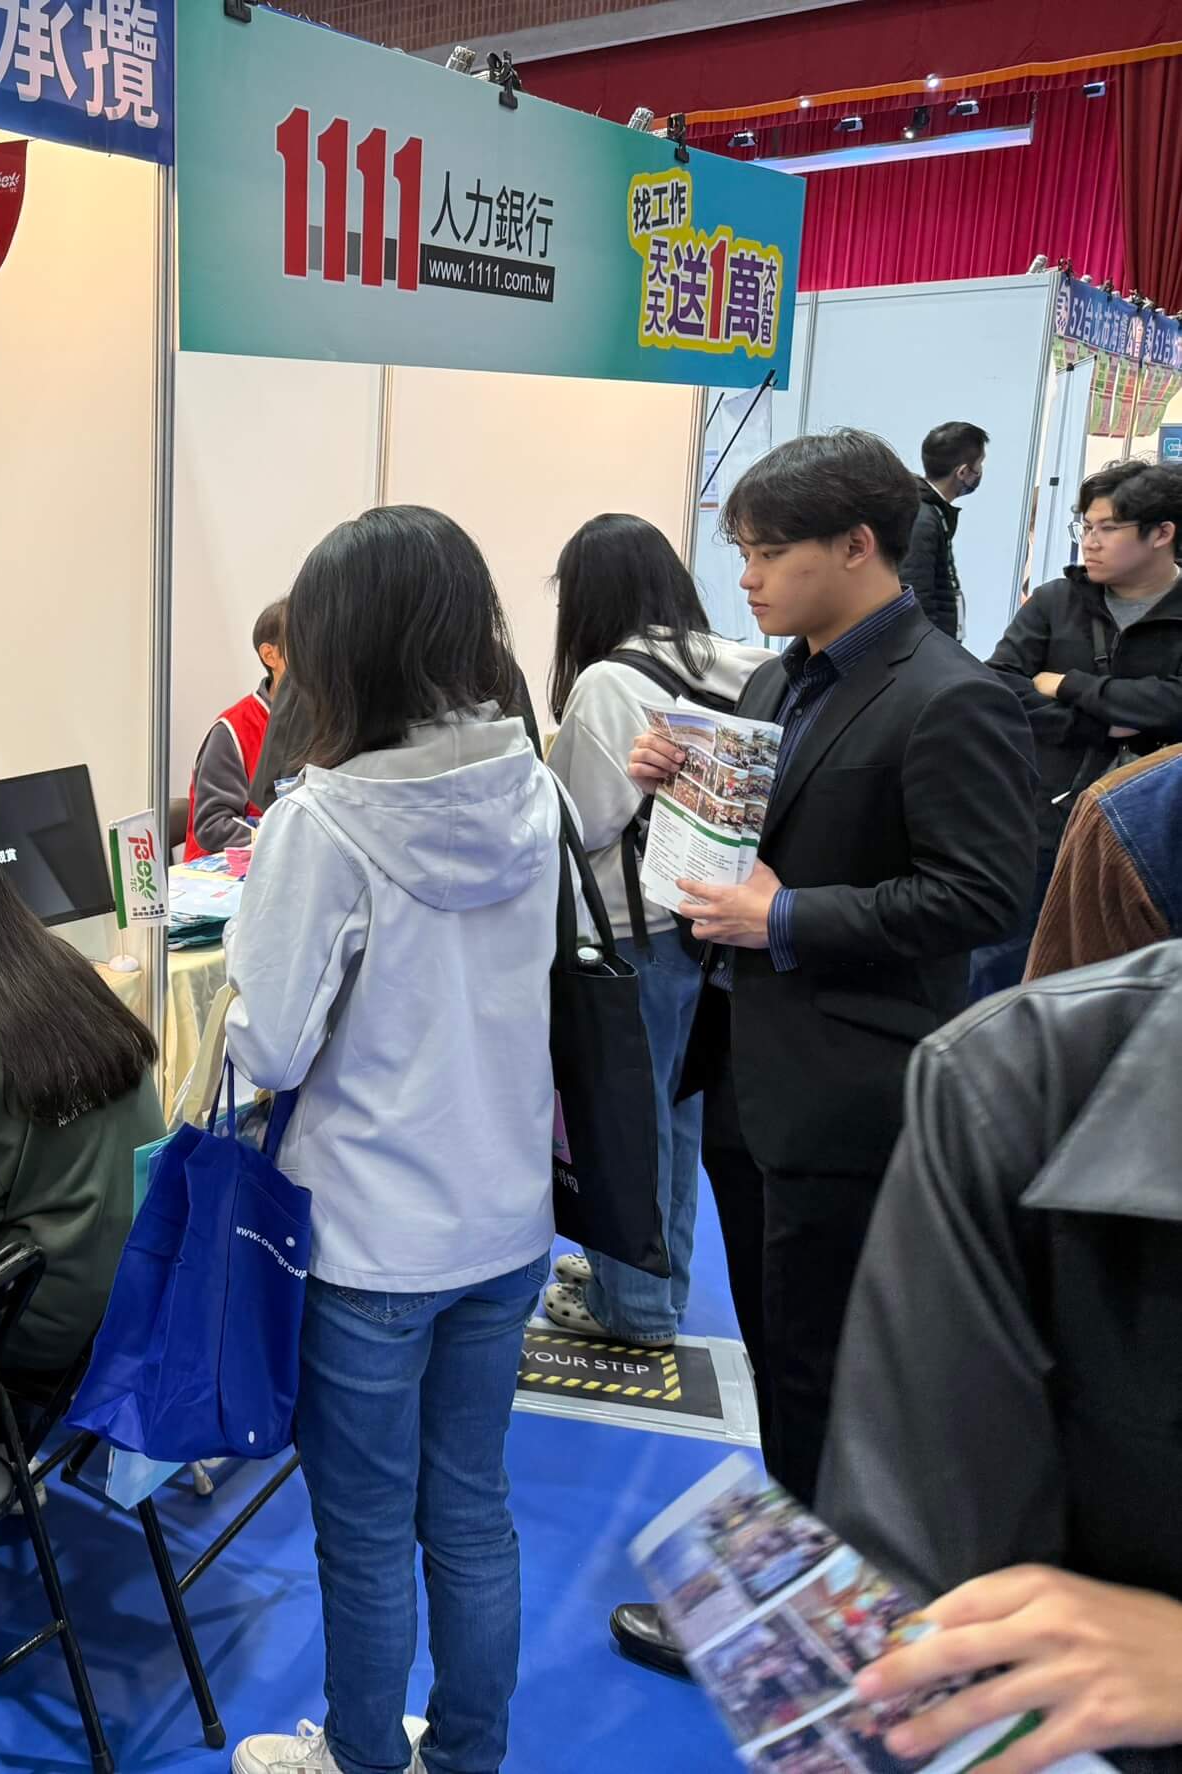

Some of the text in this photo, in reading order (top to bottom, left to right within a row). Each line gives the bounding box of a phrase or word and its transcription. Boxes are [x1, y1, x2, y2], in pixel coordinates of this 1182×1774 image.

[276, 105, 423, 291] 1111
[430, 170, 555, 259] 人力銀行
[633, 181, 687, 234] 找工作
[429, 257, 550, 297] www.1111.com.tw
[645, 238, 668, 335] 天天
[667, 239, 764, 344] 送1萬
[522, 1350, 650, 1375] YOUR STEP
